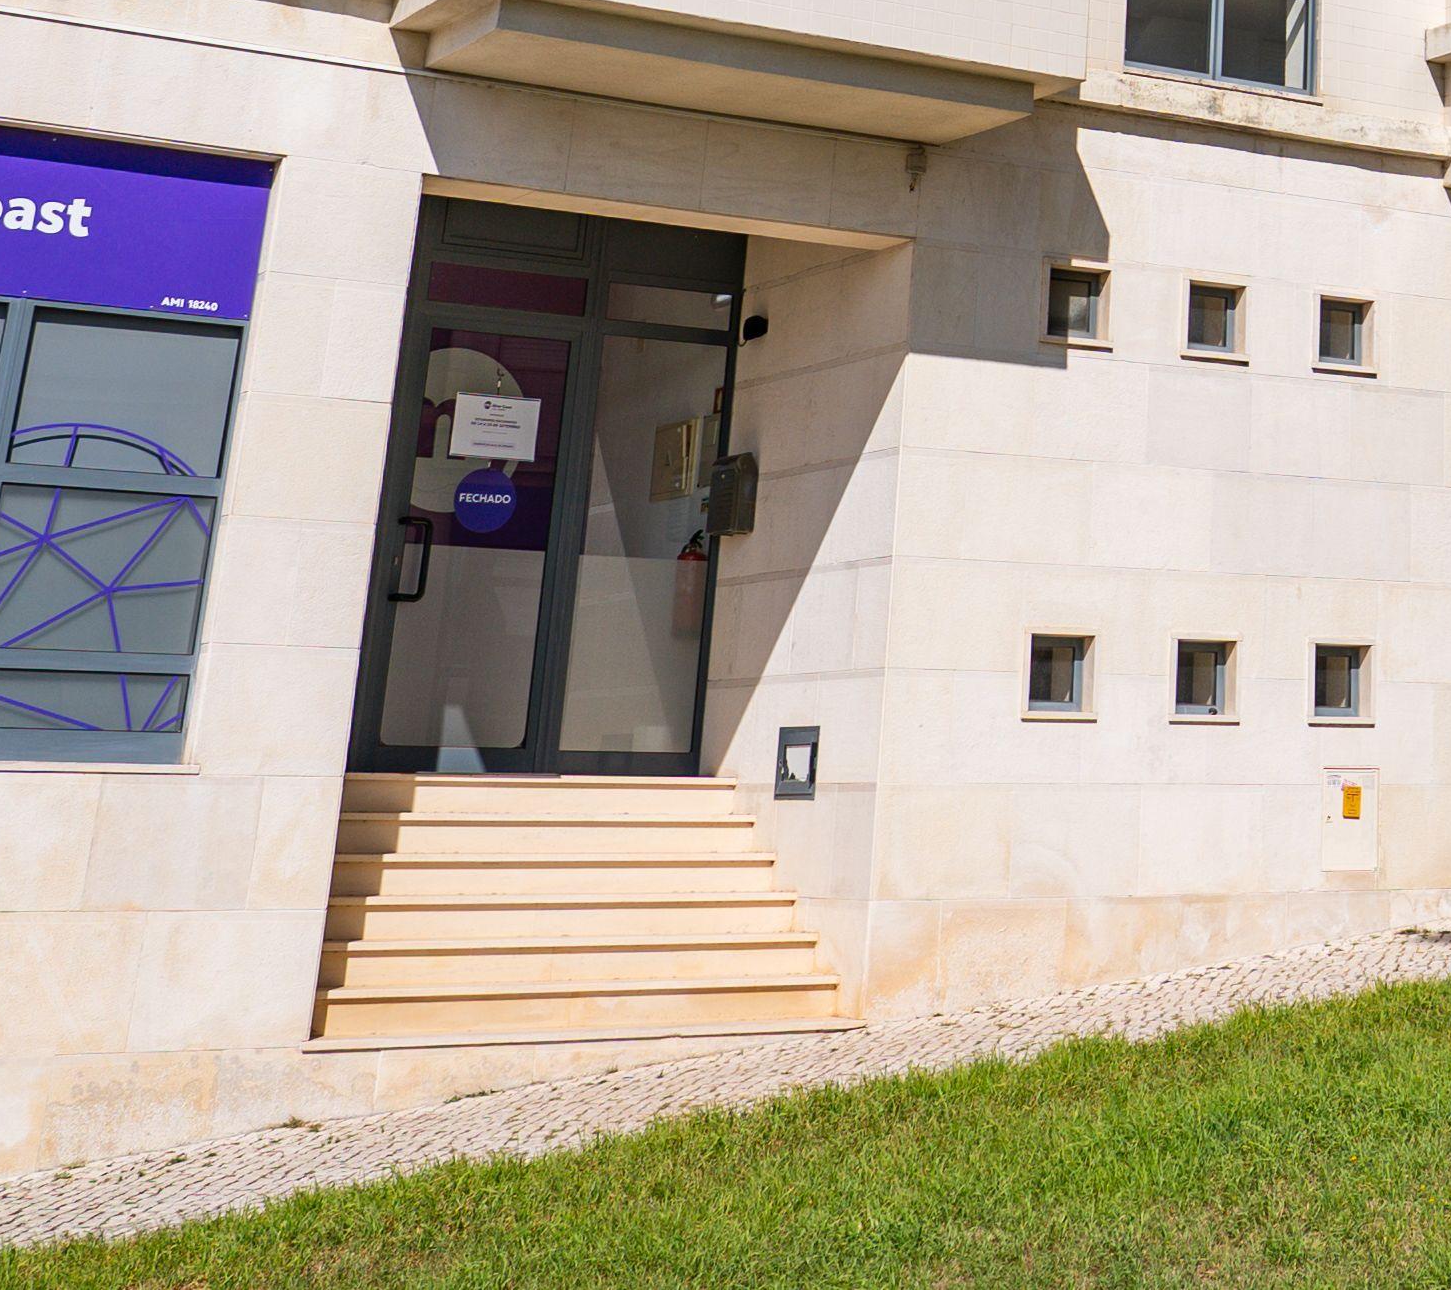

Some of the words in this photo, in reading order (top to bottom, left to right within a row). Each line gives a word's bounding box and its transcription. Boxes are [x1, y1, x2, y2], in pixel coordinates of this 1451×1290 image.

[161, 297, 184, 308] AMI
[188, 299, 219, 312] 18240
[459, 492, 512, 504] FECHADO
